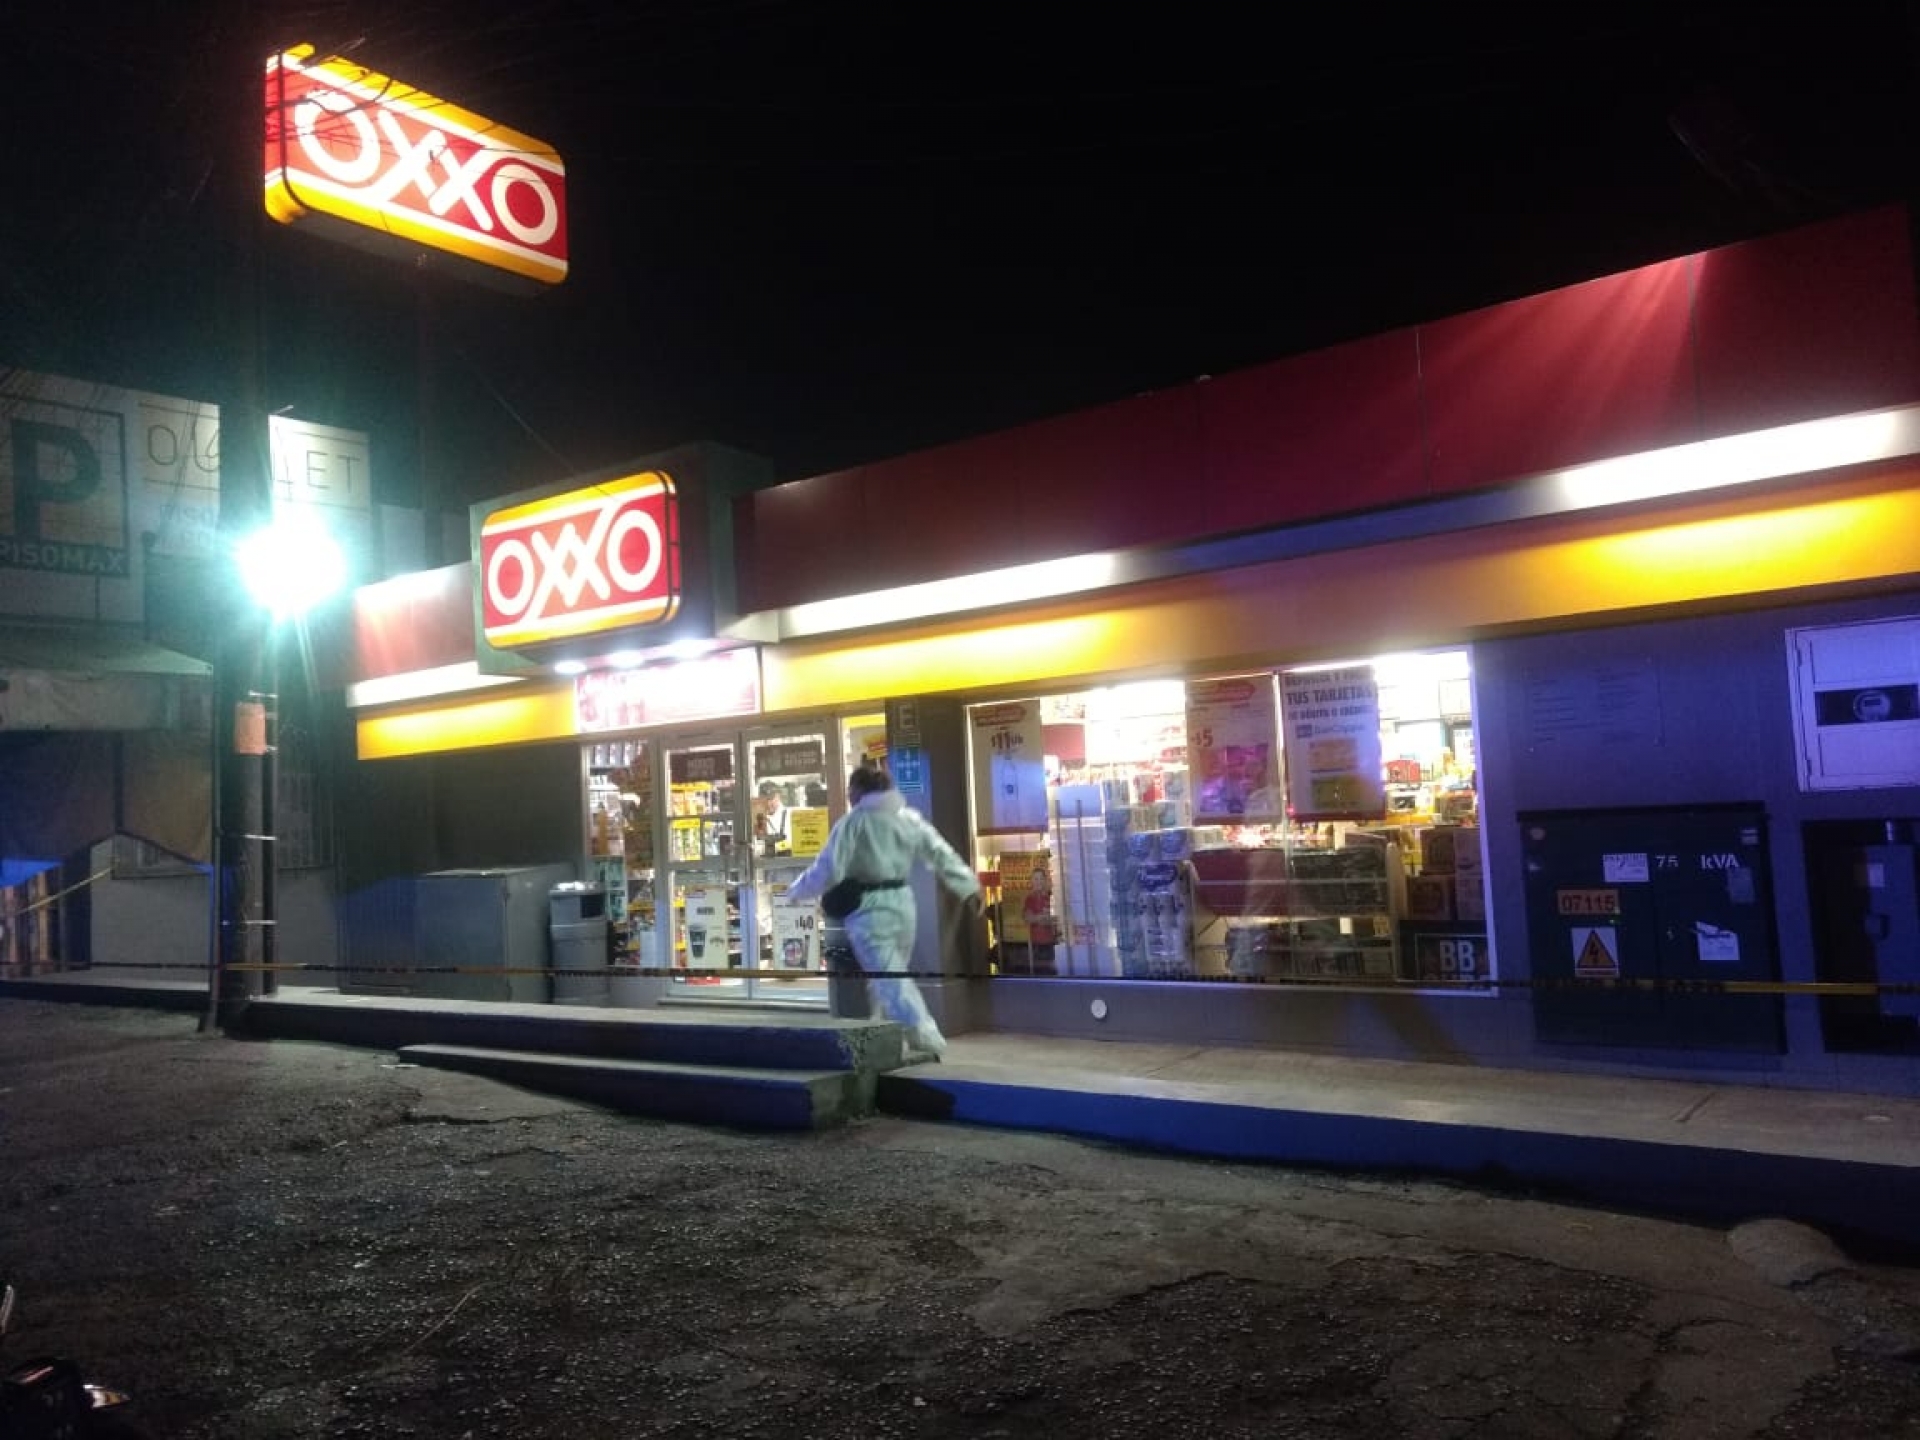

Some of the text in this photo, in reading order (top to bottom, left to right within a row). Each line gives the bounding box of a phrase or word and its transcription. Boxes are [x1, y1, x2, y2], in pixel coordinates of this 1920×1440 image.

[294, 89, 558, 245] OXXO
[12, 418, 101, 542] P
[488, 507, 662, 618] OXXO
[1286, 691, 1310, 706] TUS
[1655, 855, 1679, 868] 75
[1700, 853, 1740, 869] kVA
